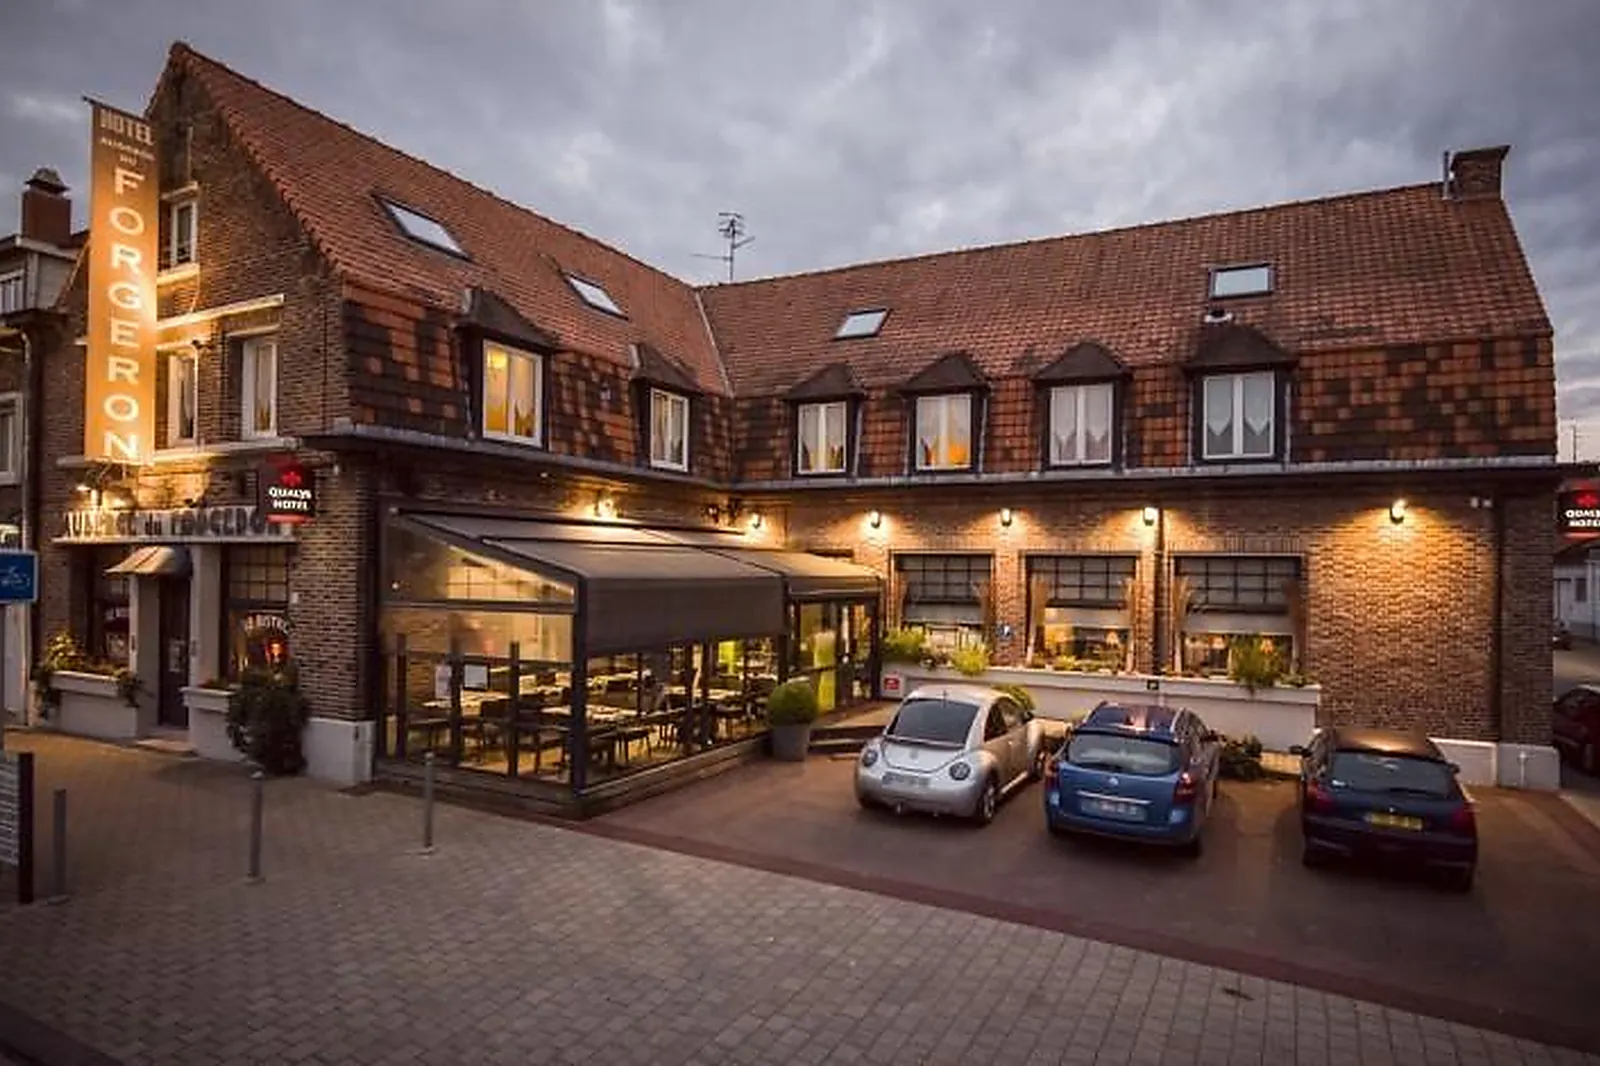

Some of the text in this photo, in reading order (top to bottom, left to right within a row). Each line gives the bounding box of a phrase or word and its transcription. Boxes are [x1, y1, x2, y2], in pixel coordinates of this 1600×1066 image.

[100, 107, 156, 146] HOTEL
[103, 166, 145, 458] FORGERON
[267, 486, 313, 500] QUALYS
[272, 499, 310, 511] HOTEL
